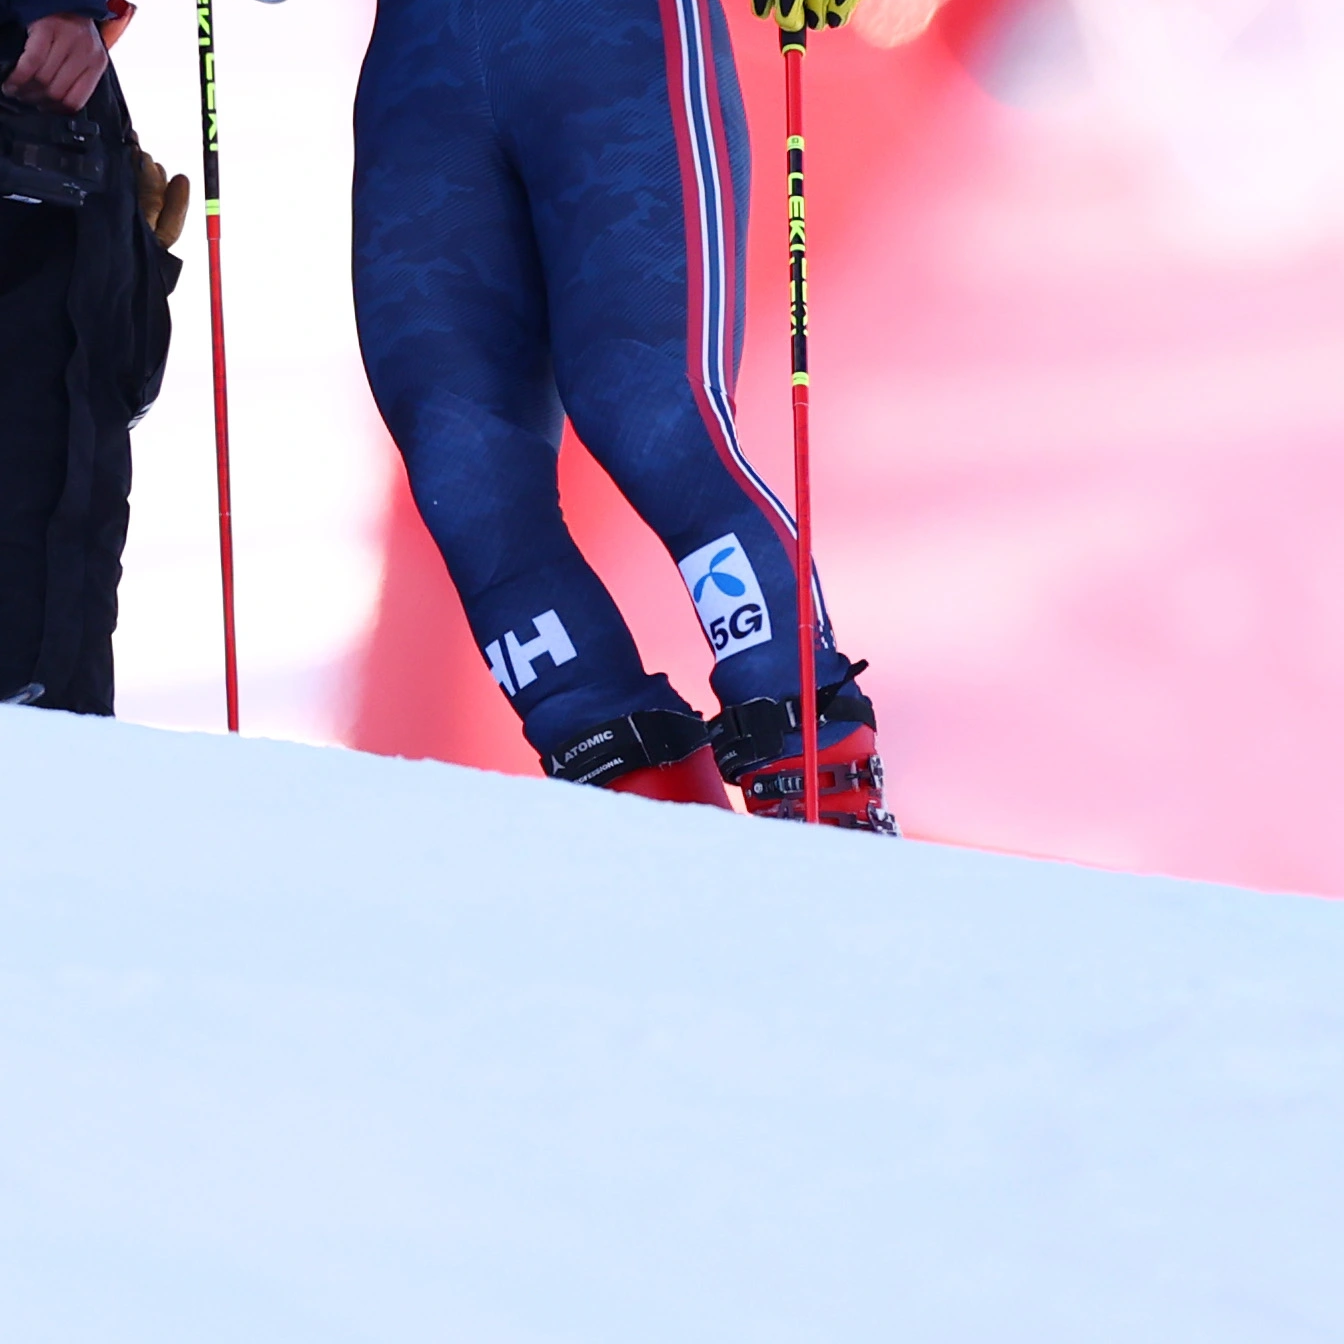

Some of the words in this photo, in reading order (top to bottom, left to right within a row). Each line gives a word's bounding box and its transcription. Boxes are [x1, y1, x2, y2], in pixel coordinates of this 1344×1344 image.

[788, 172, 806, 252] LEKI
[709, 603, 764, 652] 5G
[564, 729, 615, 763] ATOMIC
